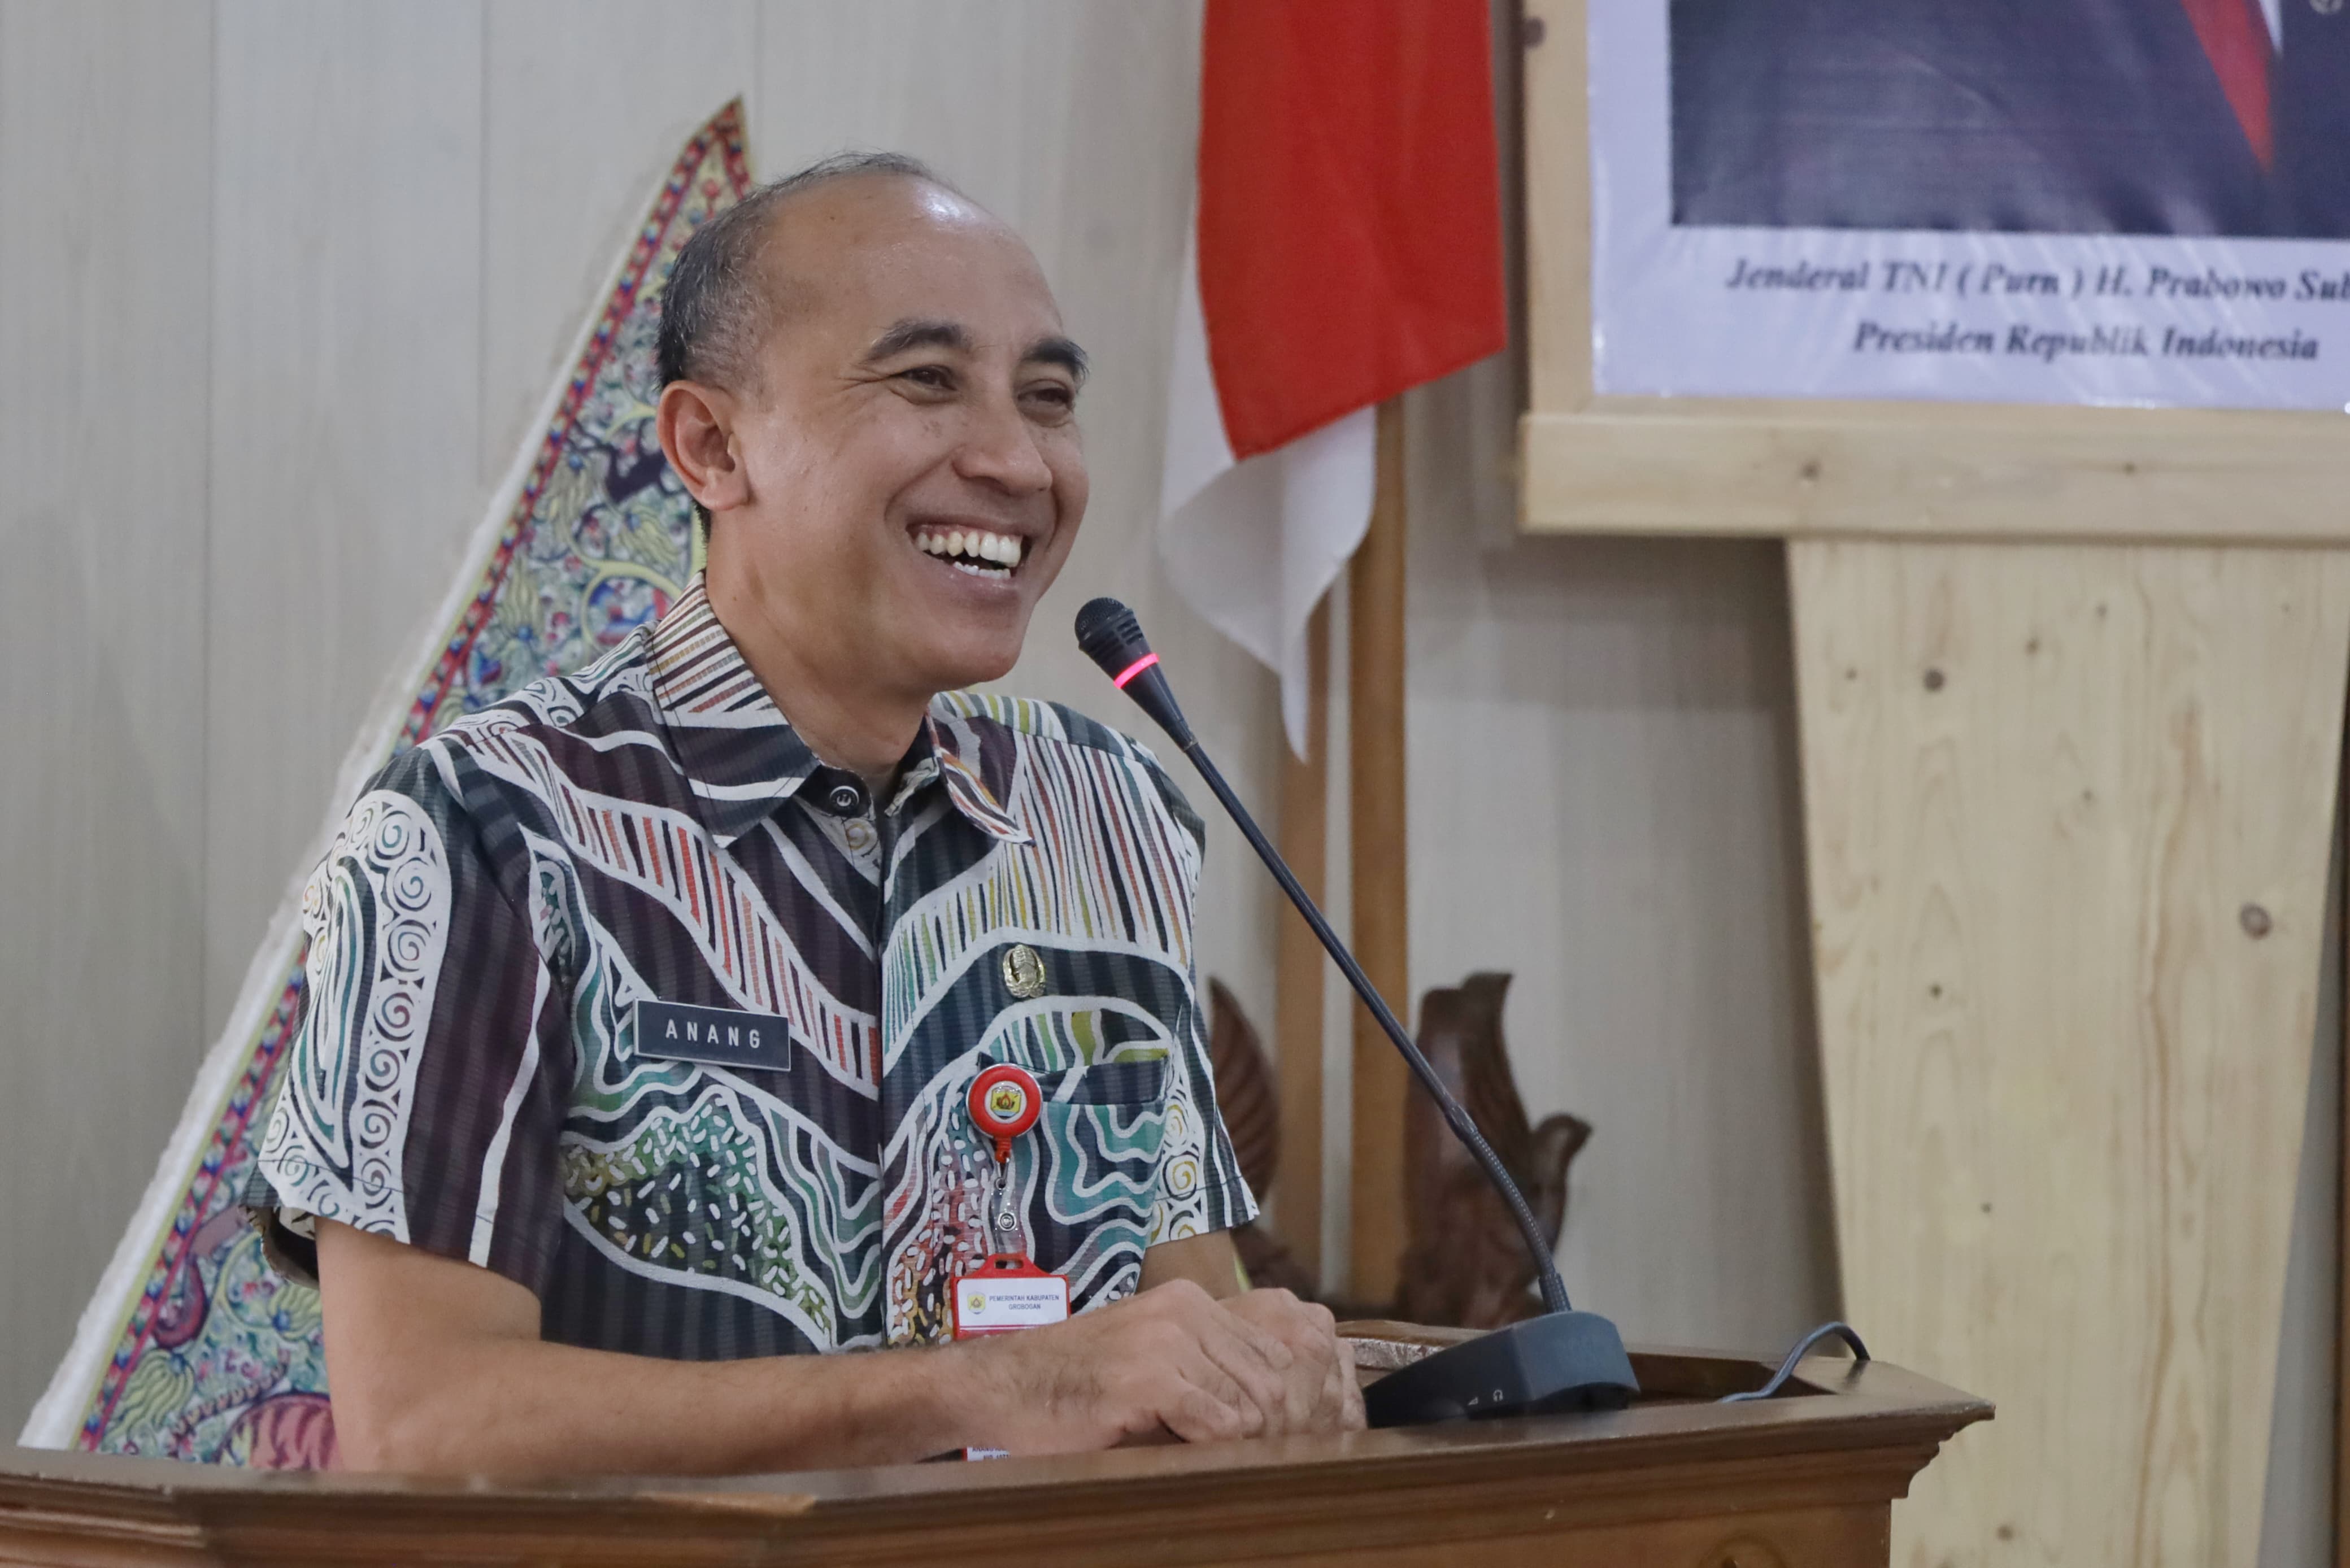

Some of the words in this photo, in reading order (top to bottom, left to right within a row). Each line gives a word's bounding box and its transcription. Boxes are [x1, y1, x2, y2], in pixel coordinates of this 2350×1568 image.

[1726, 259, 1869, 290] Jenderal
[1883, 261, 1947, 292] TNI
[2096, 264, 2133, 297] H.
[2146, 266, 2287, 299] Prabowo
[1854, 321, 1994, 354] Presiden
[2005, 324, 2148, 363] Republik
[2162, 328, 2319, 360] Indonesia
[665, 1019, 760, 1048] ANANG
